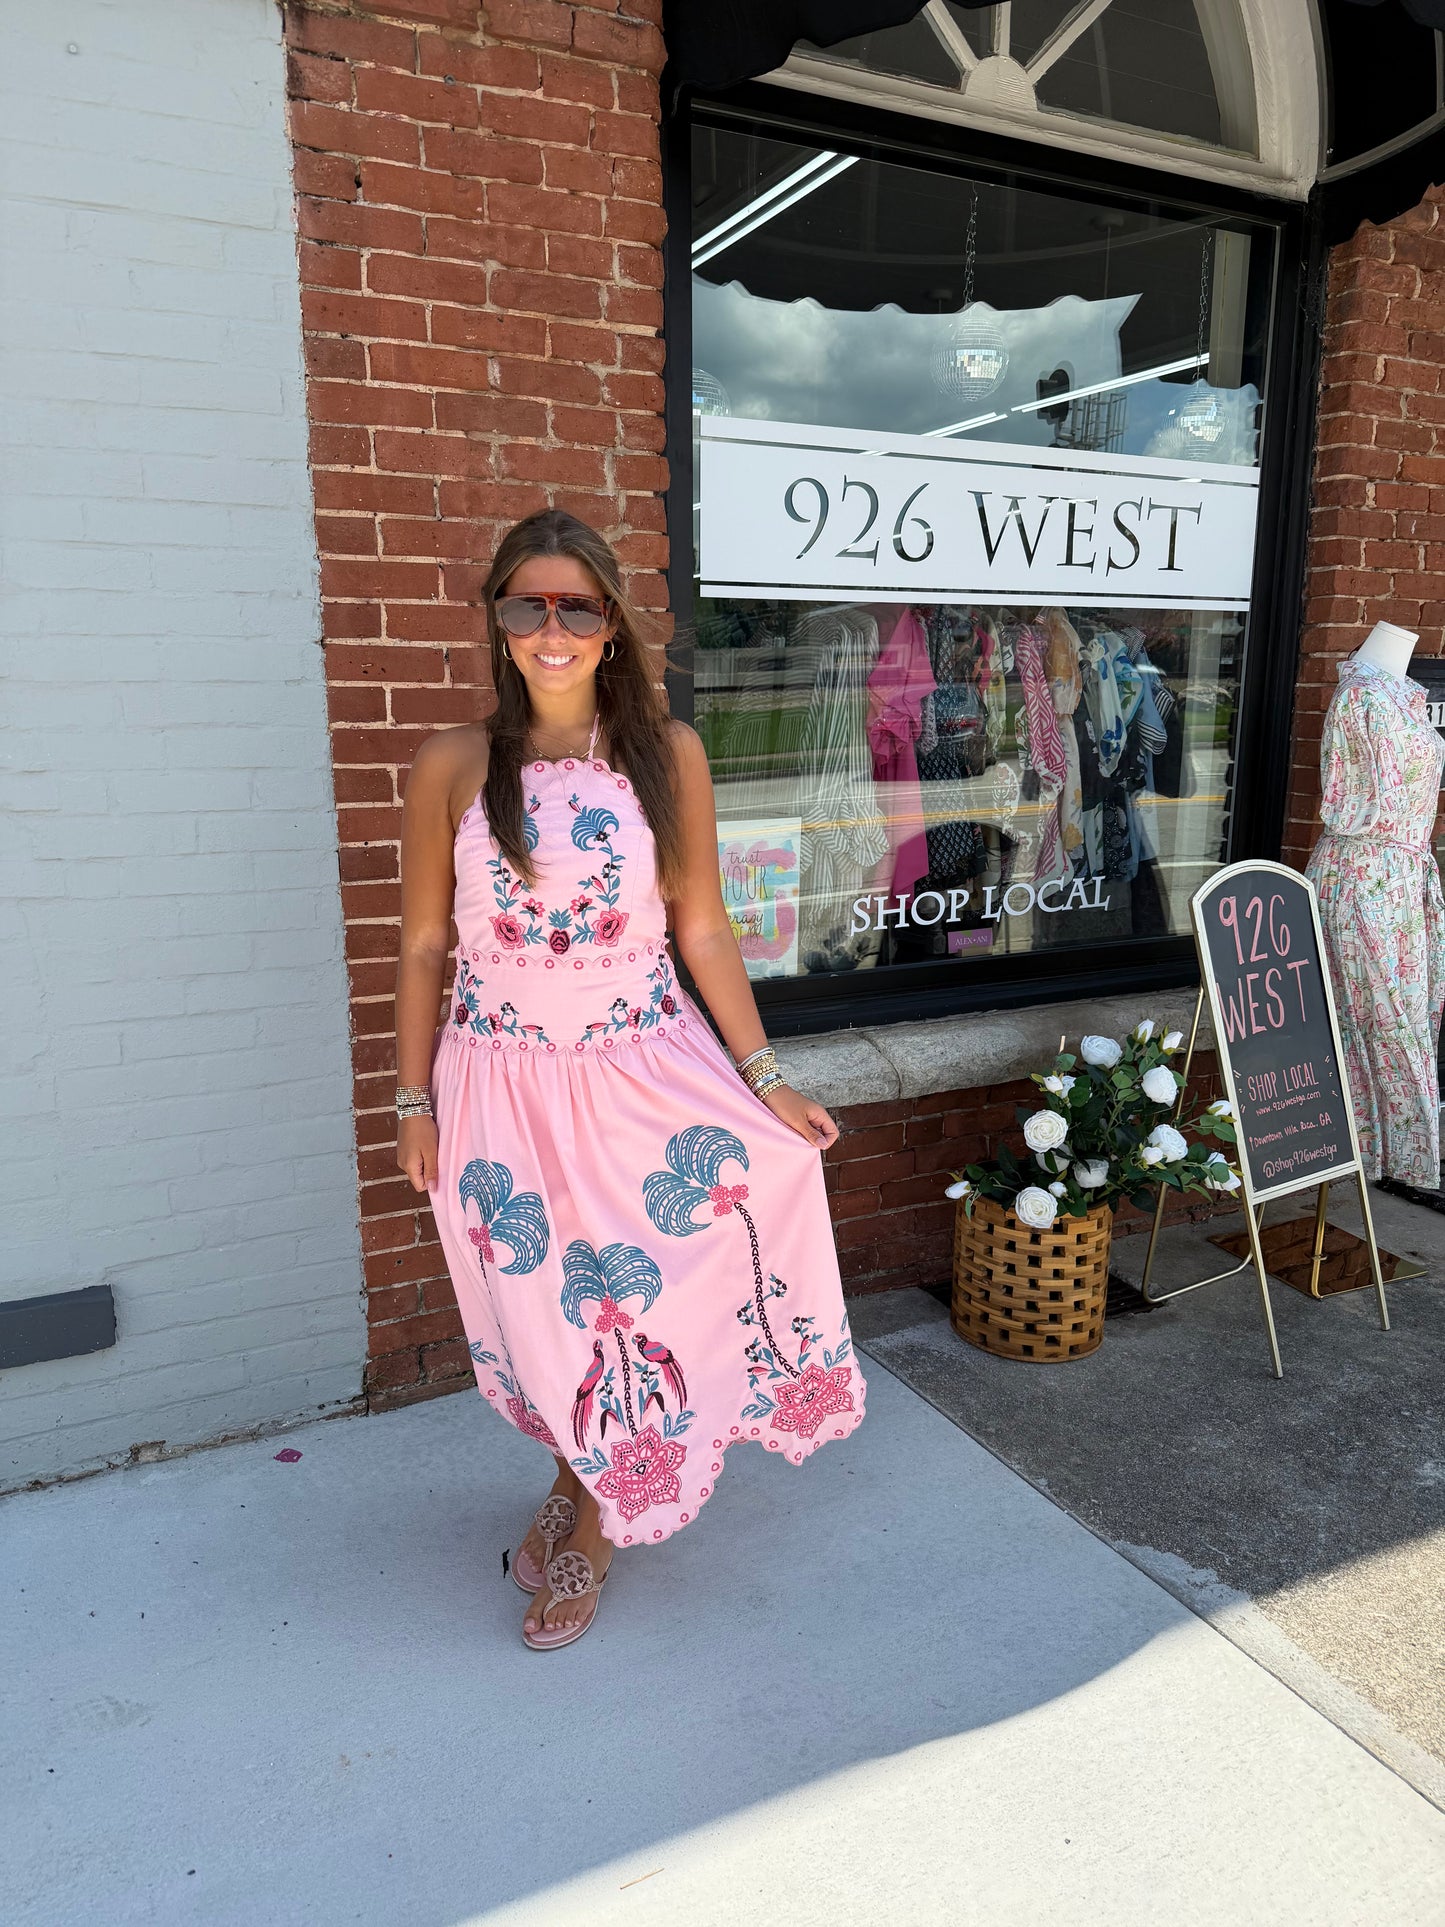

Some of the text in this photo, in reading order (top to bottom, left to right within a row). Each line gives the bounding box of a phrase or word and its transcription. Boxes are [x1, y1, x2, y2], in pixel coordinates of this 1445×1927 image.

[784, 474, 1203, 577] 926 WEST
[726, 850, 762, 864] trust
[722, 865, 769, 901] YOUR
[850, 876, 1111, 937] SHOP LOCAL
[1218, 894, 1291, 965] 926
[1216, 959, 1310, 1043] WEST
[1247, 1062, 1319, 1102] SHOP LOCAL
[1255, 1091, 1321, 1116] www.926westga.com
[1254, 1132, 1283, 1148] Downtown
[1284, 1125, 1299, 1137] Villa
[1318, 1112, 1332, 1126] GA
[1262, 1144, 1337, 1178] @shop926westga
